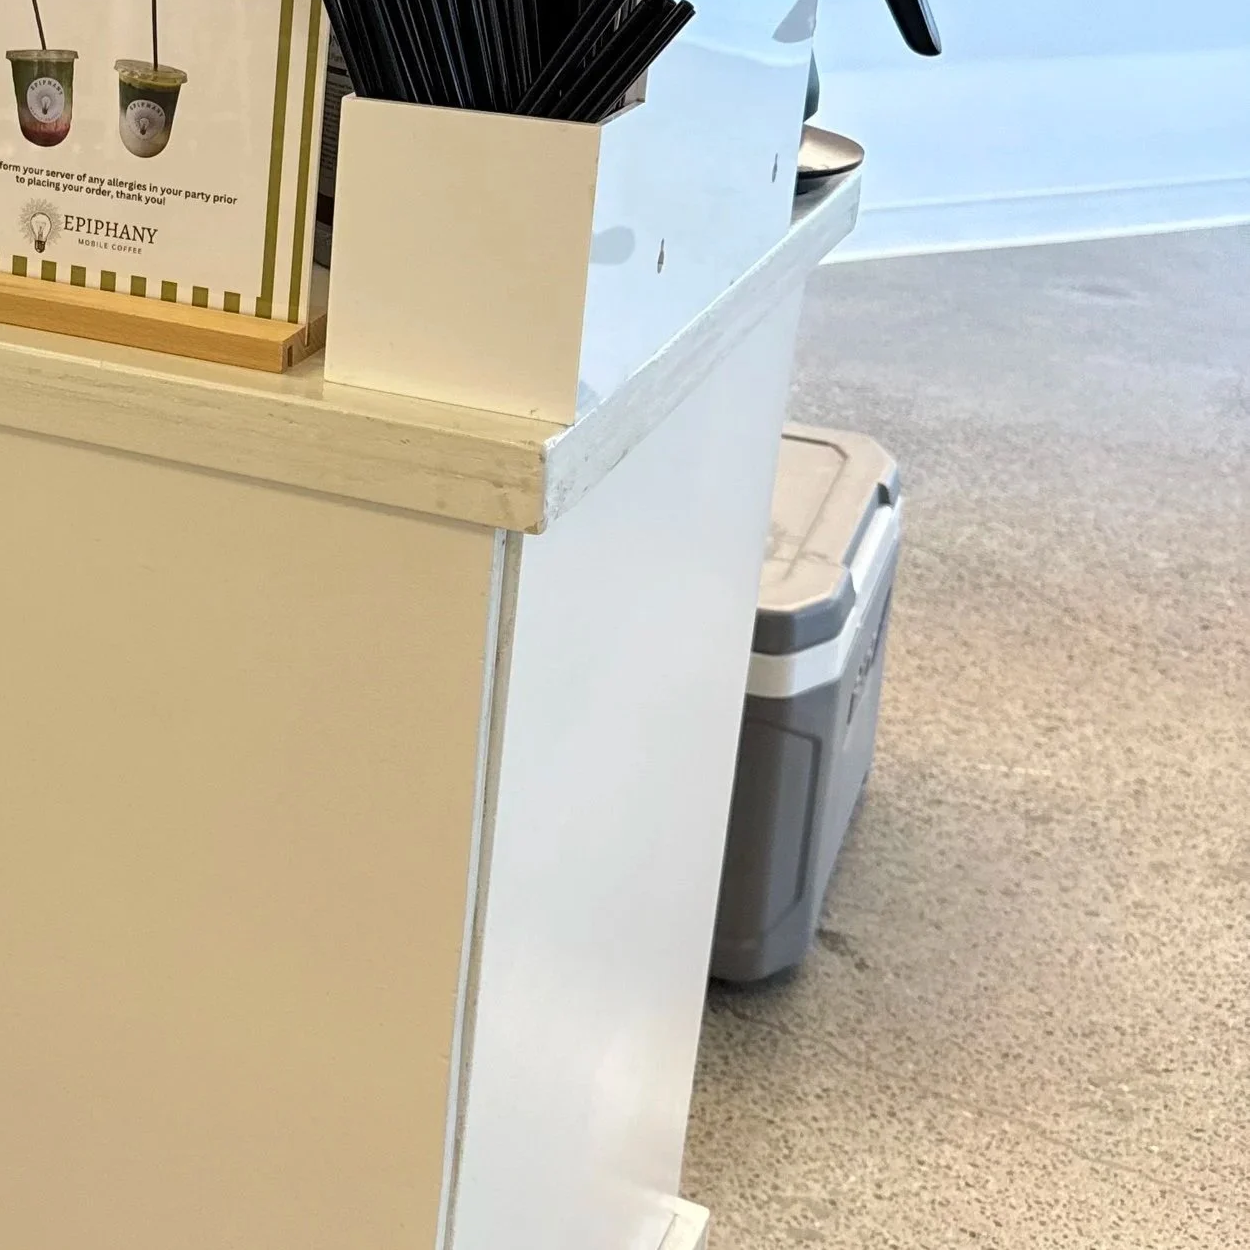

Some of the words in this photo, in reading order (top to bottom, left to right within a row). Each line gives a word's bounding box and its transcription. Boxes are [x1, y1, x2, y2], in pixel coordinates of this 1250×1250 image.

[15, 175, 25, 184] to
[27, 176, 61, 191] placing
[62, 182, 83, 193] your
[85, 185, 114, 199] order,
[116, 190, 143, 202] thank
[144, 195, 166, 206] you!
[22, 165, 44, 176] your
[45, 169, 75, 180] server
[76, 173, 87, 182] of
[88, 175, 105, 187] any
[107, 177, 147, 191] allergies
[149, 183, 158, 193] in
[160, 186, 183, 197] your
[184, 190, 211, 203] party
[213, 194, 238, 205] prior
[63, 214, 158, 244] EPIPHANY
[78, 238, 108, 249] MOBILE
[111, 243, 142, 255] COFFEE
